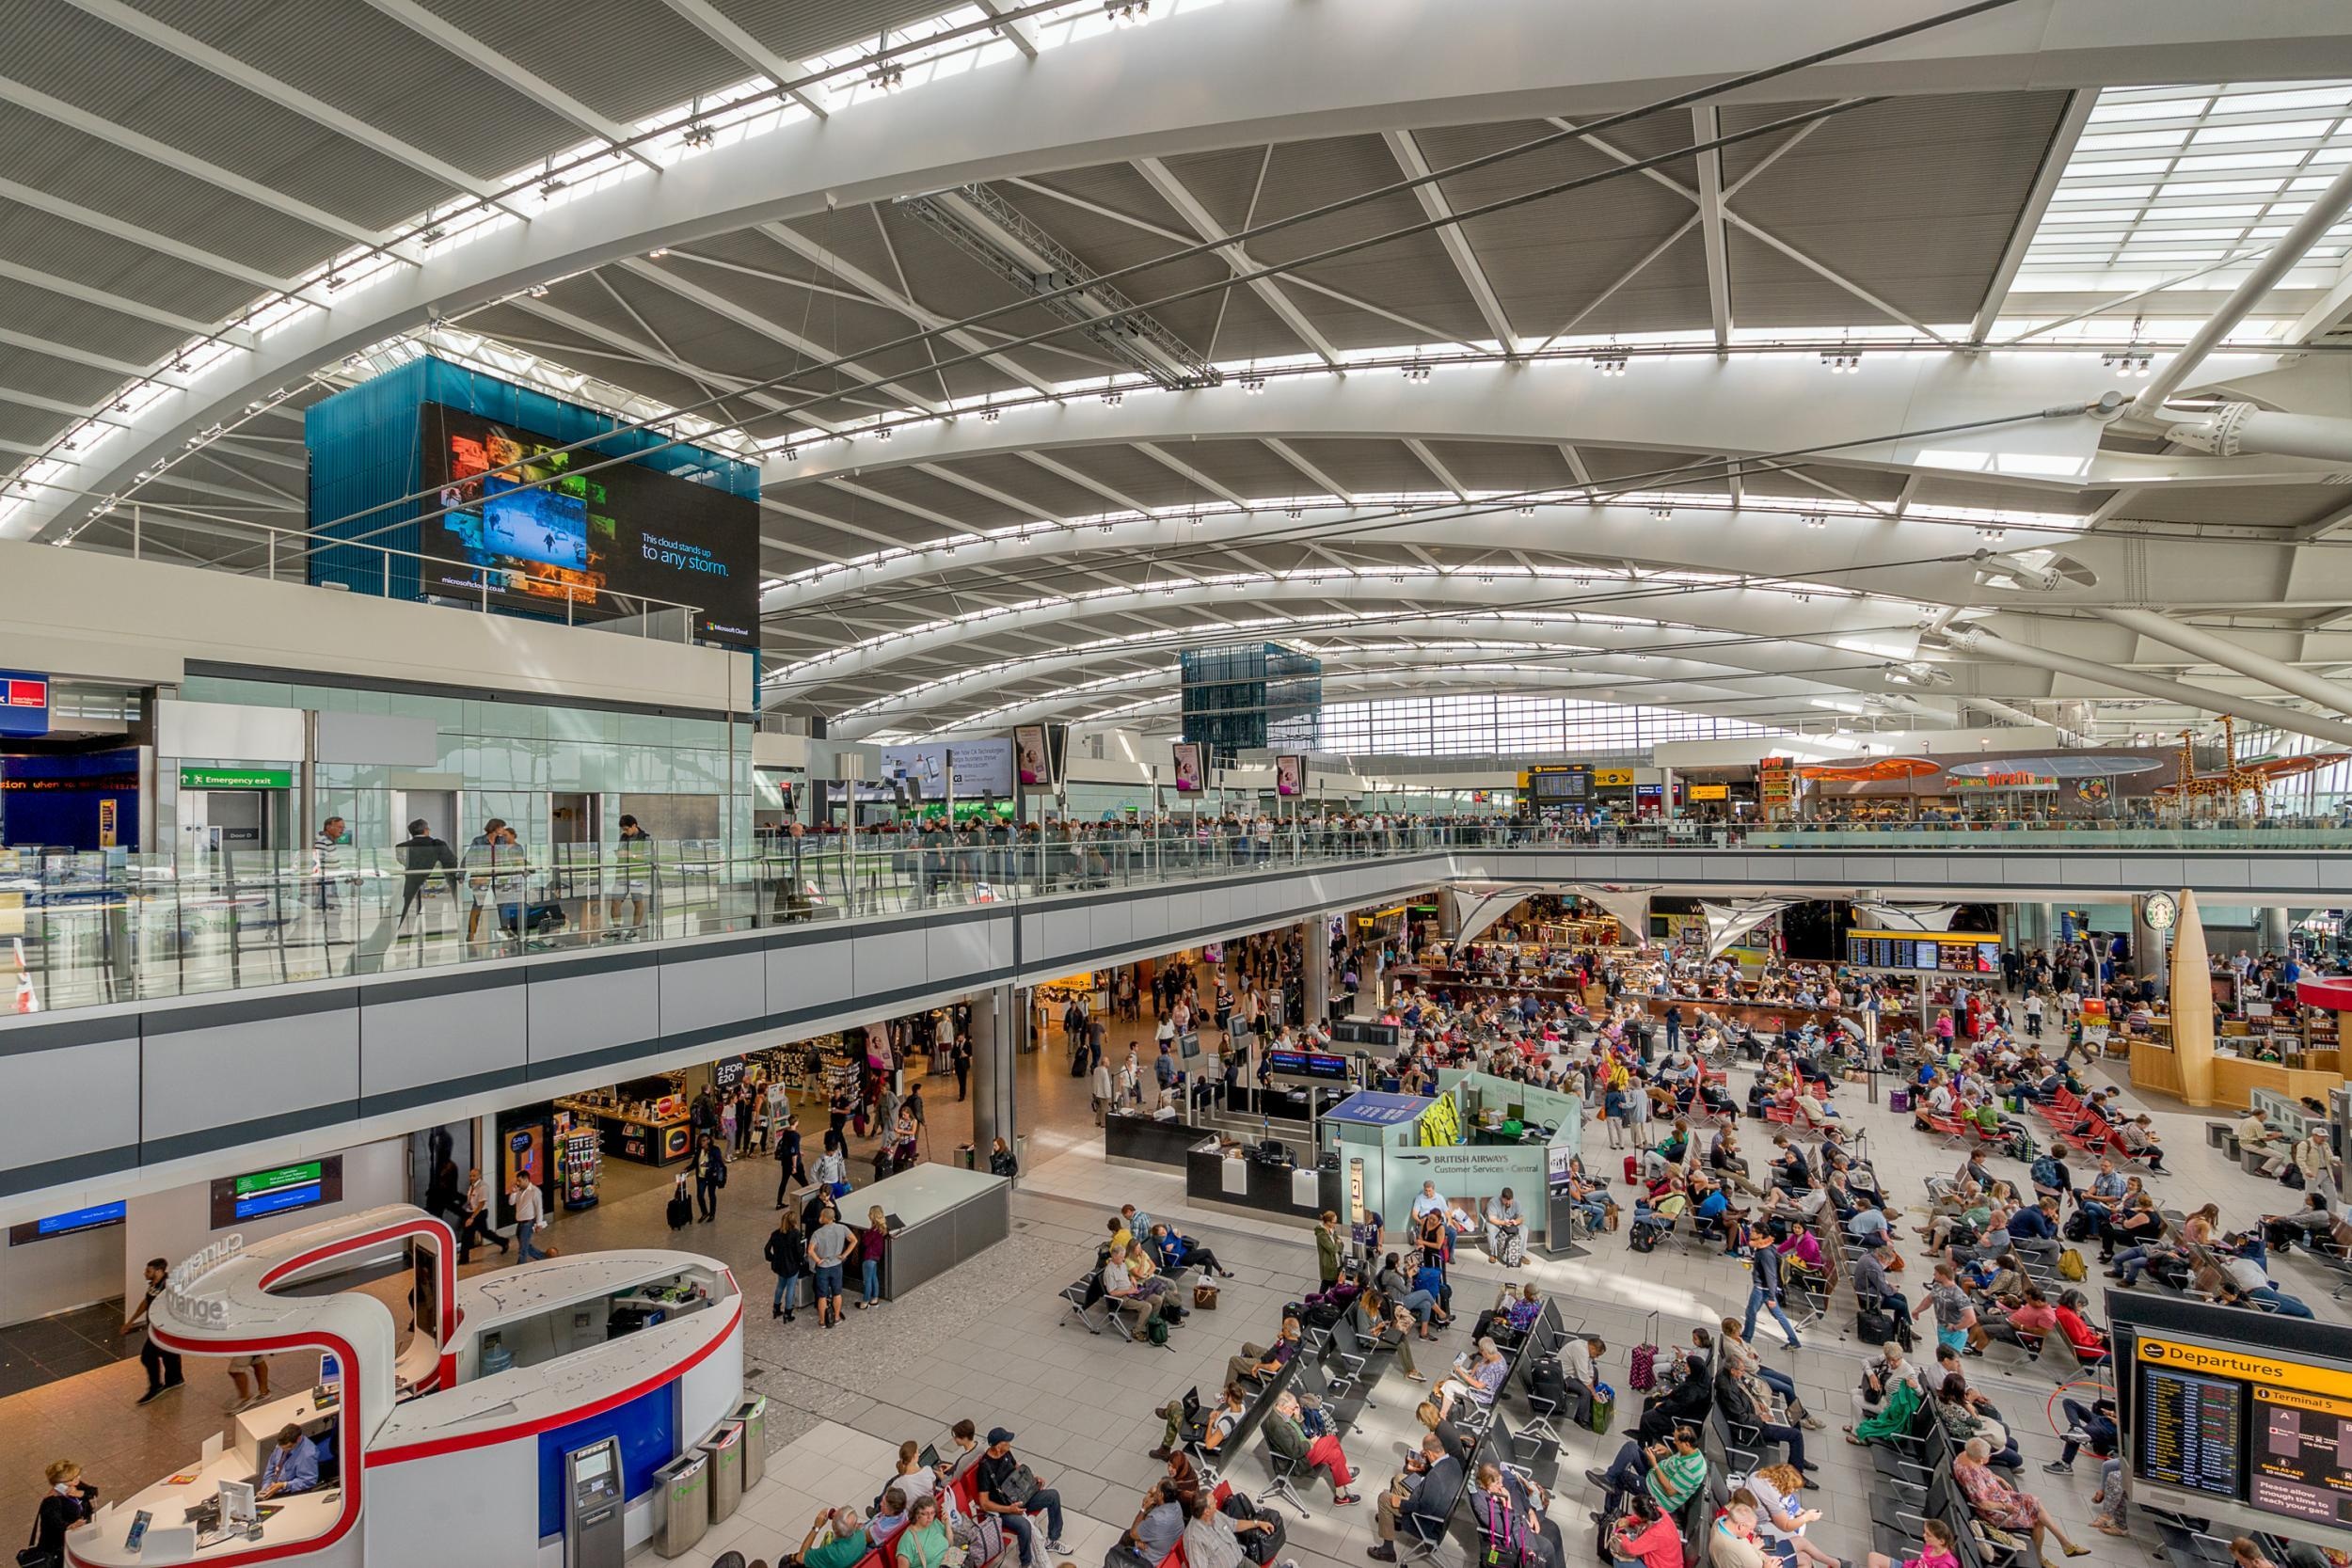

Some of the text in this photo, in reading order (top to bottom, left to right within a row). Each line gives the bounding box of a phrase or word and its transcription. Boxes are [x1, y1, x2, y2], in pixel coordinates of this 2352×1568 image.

[642, 532, 712, 559] This cloud stands up
[642, 544, 729, 577] to any storm.
[715, 625, 749, 636] Microsoft Cloud
[205, 776, 253, 785] Emergency
[953, 774, 962, 783] ca
[717, 1063, 743, 1076] 2 FOR
[718, 1073, 735, 1085] £20
[1434, 1155, 1508, 1164] BRITISH AIRWAYS
[1434, 1165, 1470, 1174] Customer
[1472, 1164, 1504, 1173] Services
[1511, 1164, 1538, 1173] Central
[2169, 1347, 2284, 1378] Departures
[2273, 1391, 2333, 1409] Terminal 5
[2280, 1412, 2290, 1420] A
[2313, 1442, 2334, 1451] transit
[2261, 1463, 2280, 1471] Gates
[2273, 1470, 2301, 1481] minutes
[2260, 1481, 2316, 1498] Please allow
[2260, 1489, 2329, 1510] enough time to
[2260, 1496, 2329, 1516] reach your gate
